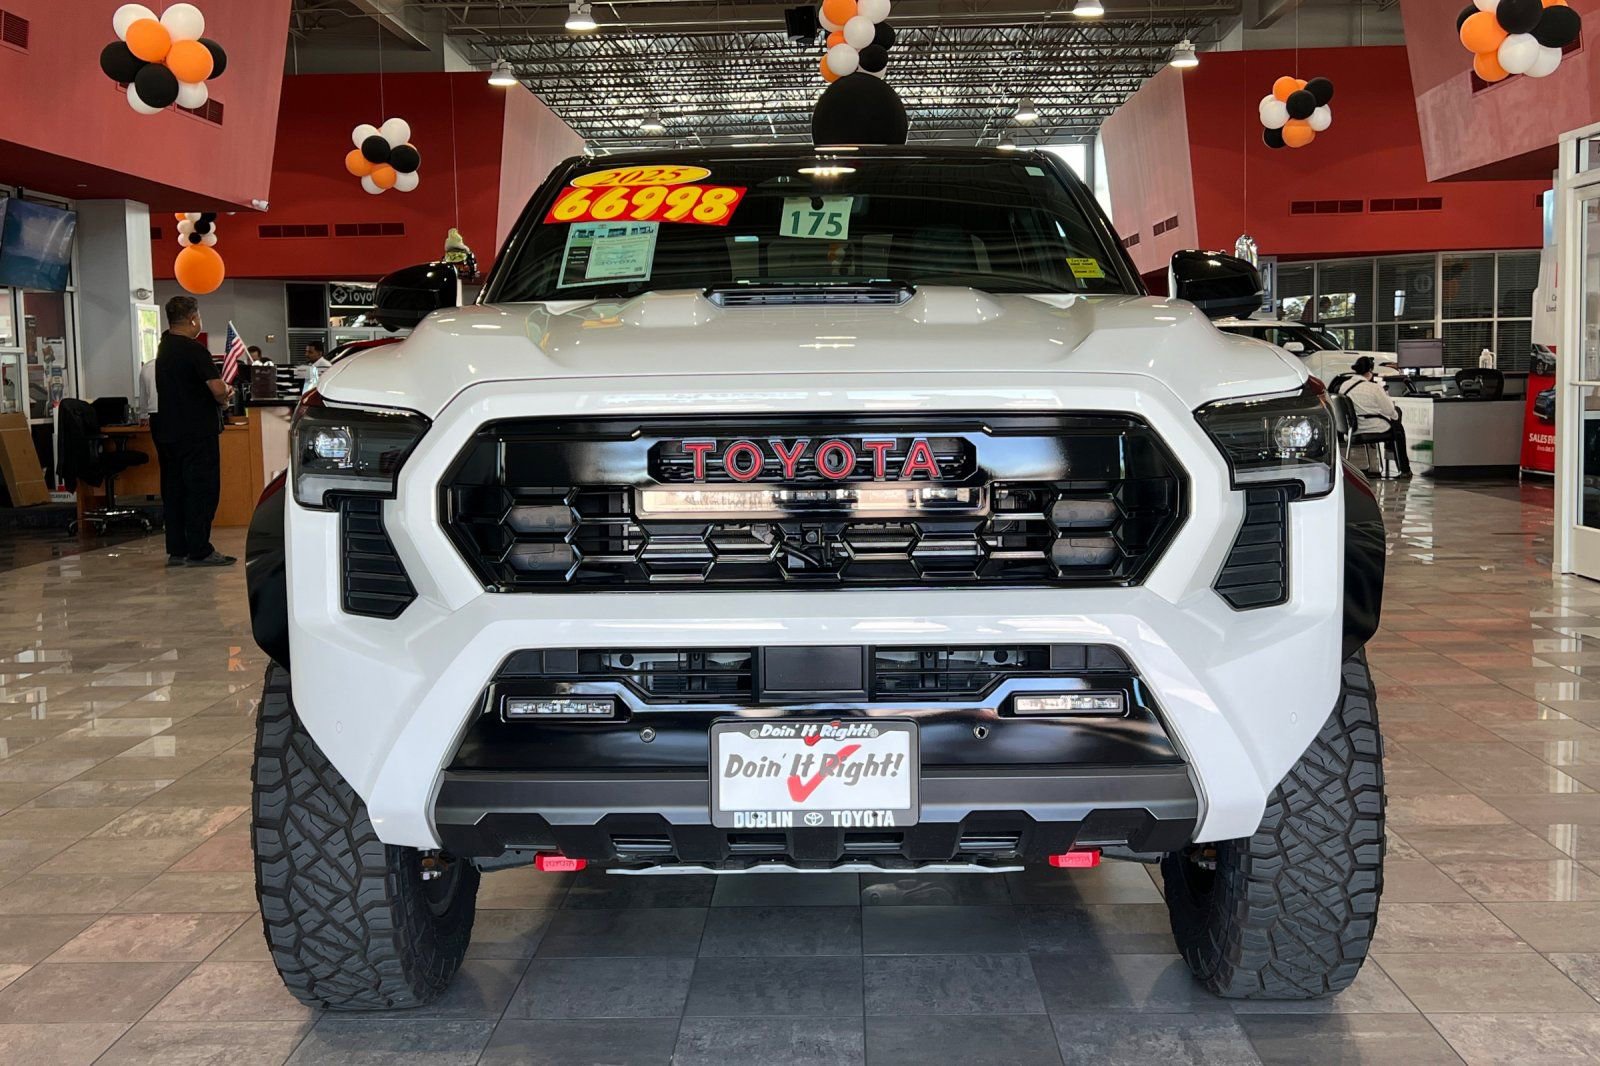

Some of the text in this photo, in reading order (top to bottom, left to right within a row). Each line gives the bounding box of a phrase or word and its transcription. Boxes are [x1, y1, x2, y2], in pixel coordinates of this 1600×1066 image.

[595, 166, 689, 185] 2025
[551, 184, 740, 223] 66998
[791, 210, 843, 237] 175
[1528, 432, 1547, 444] SALES
[682, 437, 943, 482] TOYOTA
[759, 722, 871, 741] Doin' It Right!
[724, 752, 904, 786] Doin' It Right!
[733, 810, 895, 828] DUBLIN TOYOTA
